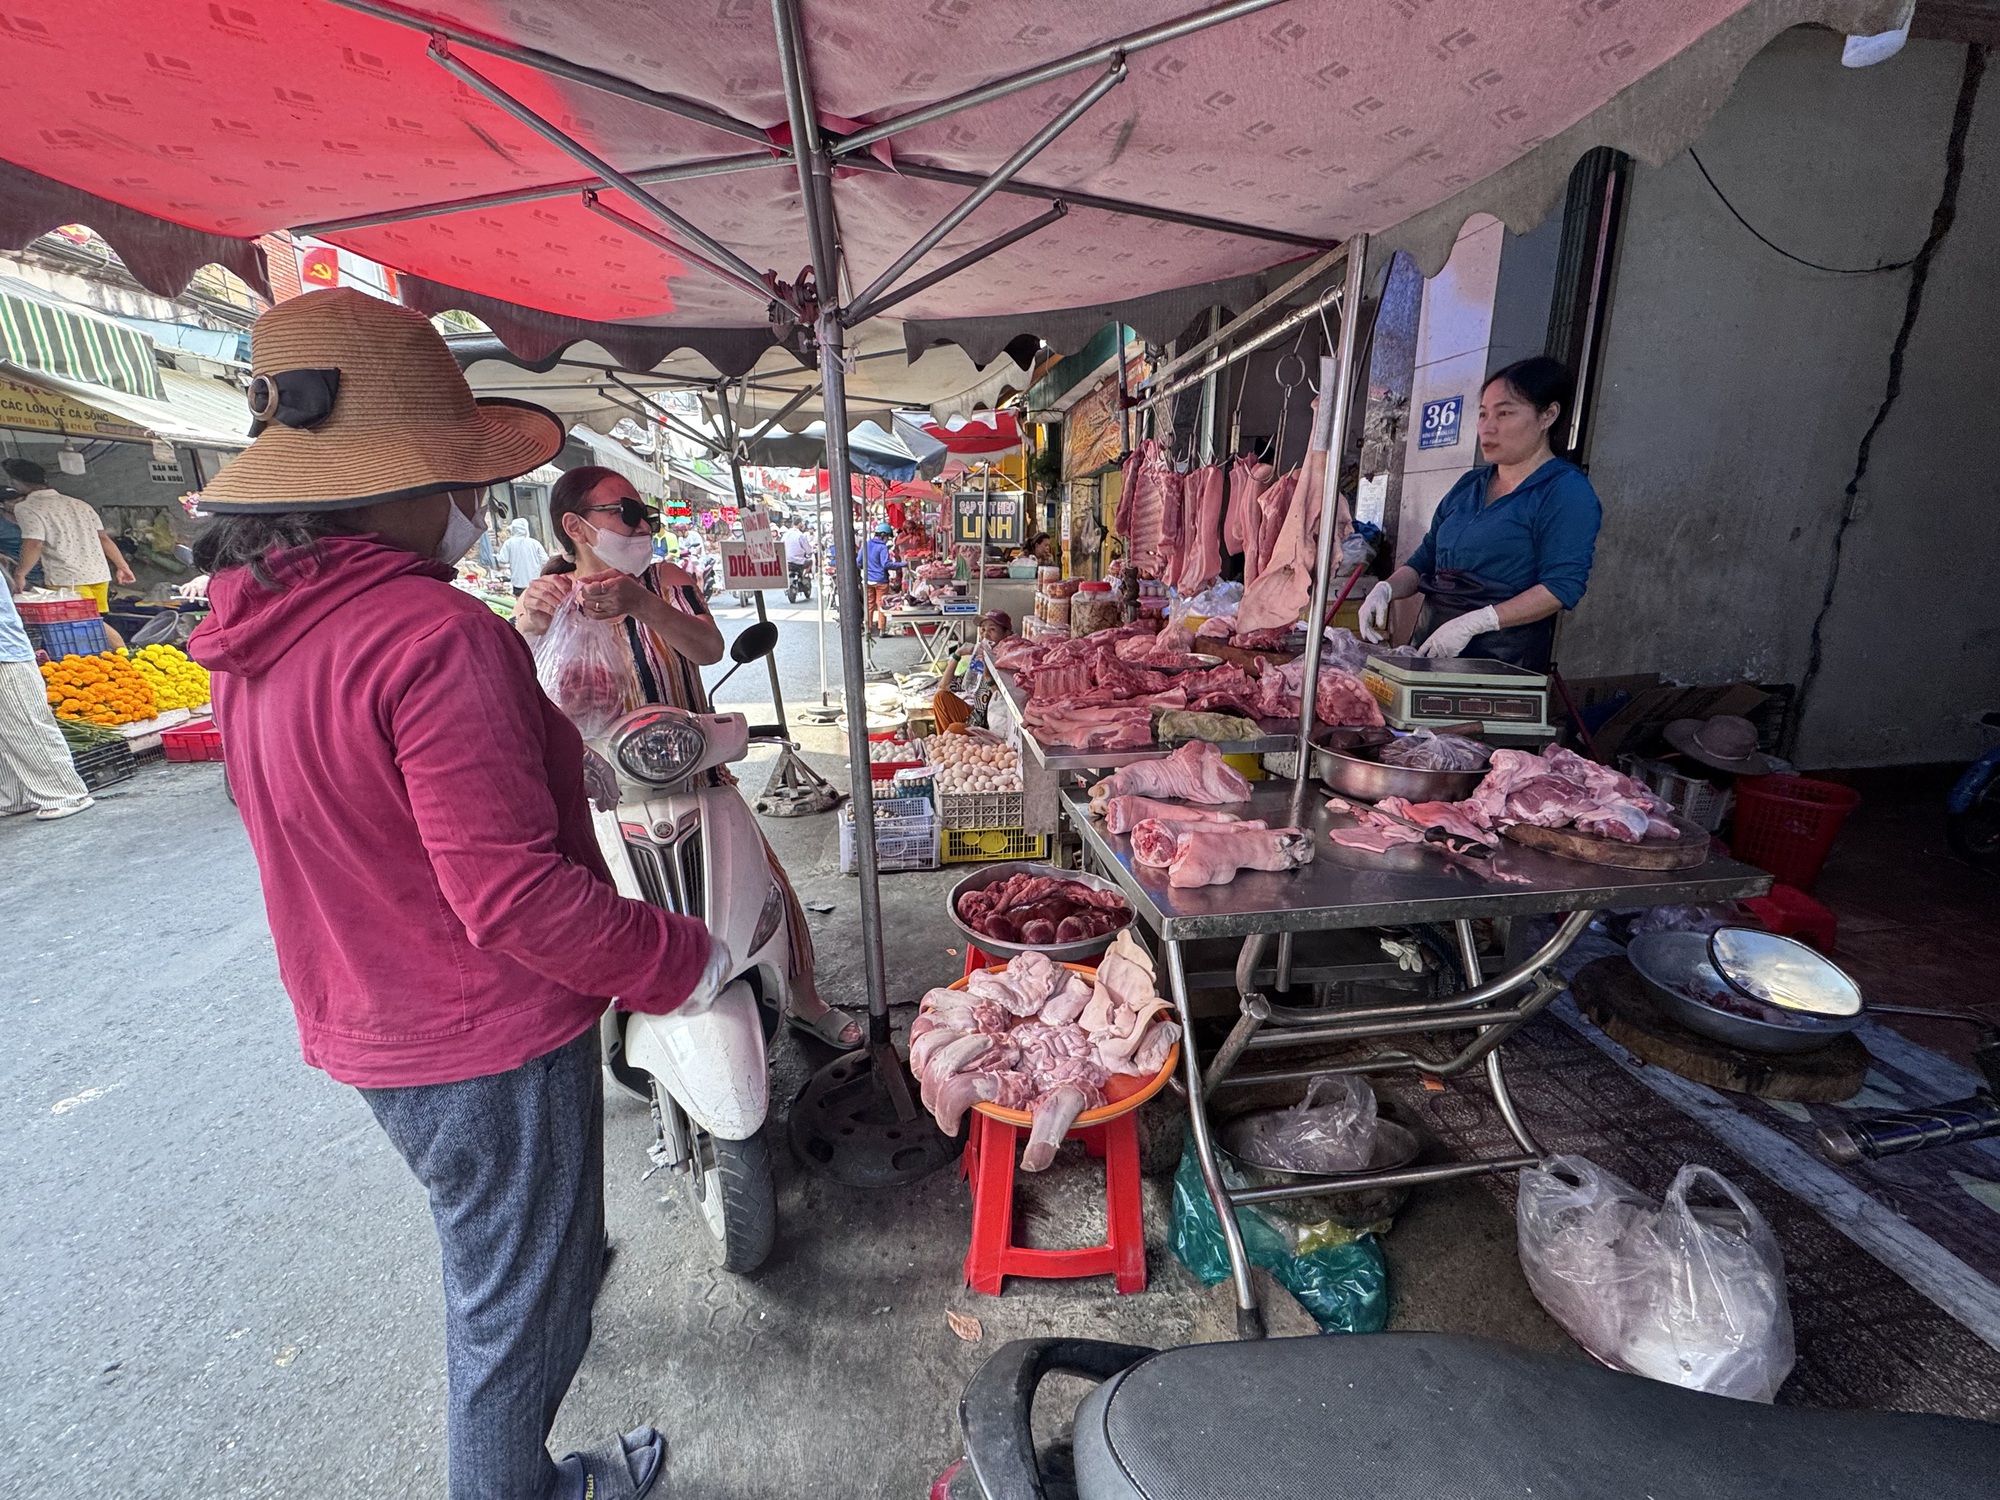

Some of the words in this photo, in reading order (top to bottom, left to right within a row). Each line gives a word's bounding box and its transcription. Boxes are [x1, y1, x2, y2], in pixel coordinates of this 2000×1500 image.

[1425, 401, 1456, 429] 36
[977, 501, 997, 516] TỊT
[997, 501, 1016, 515] HEO
[963, 516, 1012, 539] LINH
